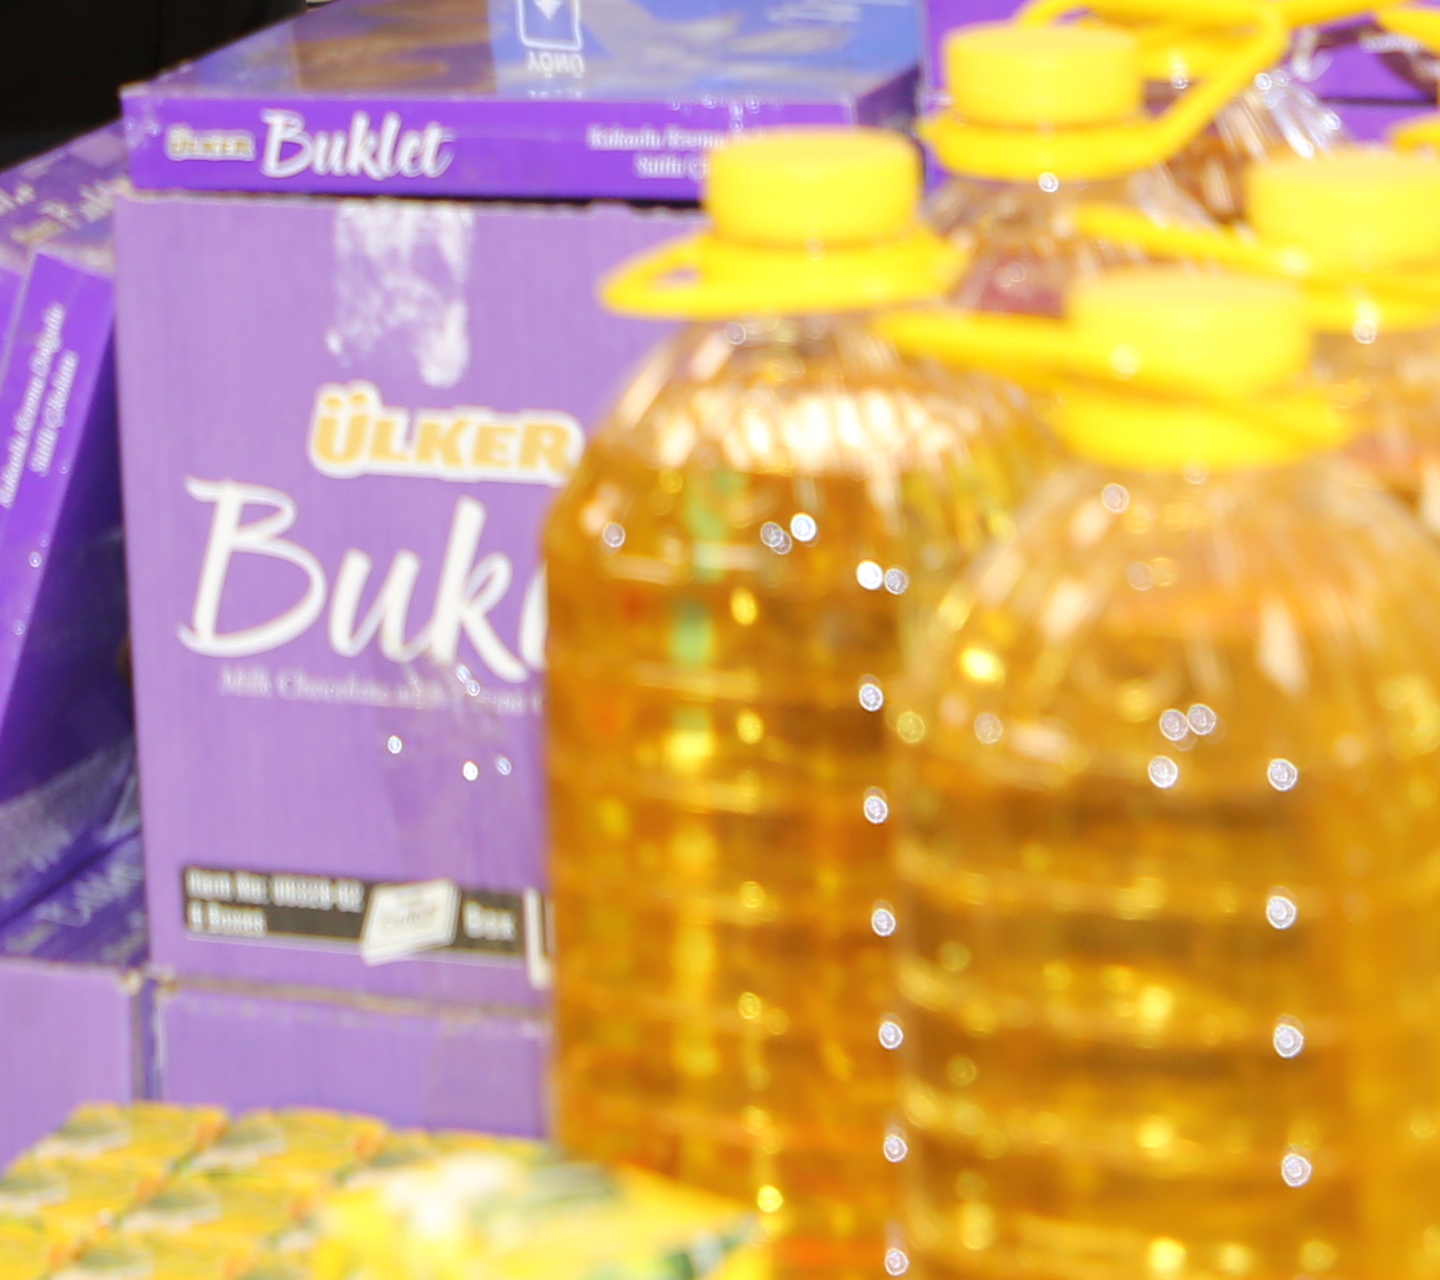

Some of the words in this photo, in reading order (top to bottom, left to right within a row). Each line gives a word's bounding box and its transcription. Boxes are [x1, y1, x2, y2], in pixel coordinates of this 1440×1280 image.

[260, 108, 456, 180] Buklet
[312, 382, 582, 484] ÜLKER
[177, 476, 548, 684] Buk
